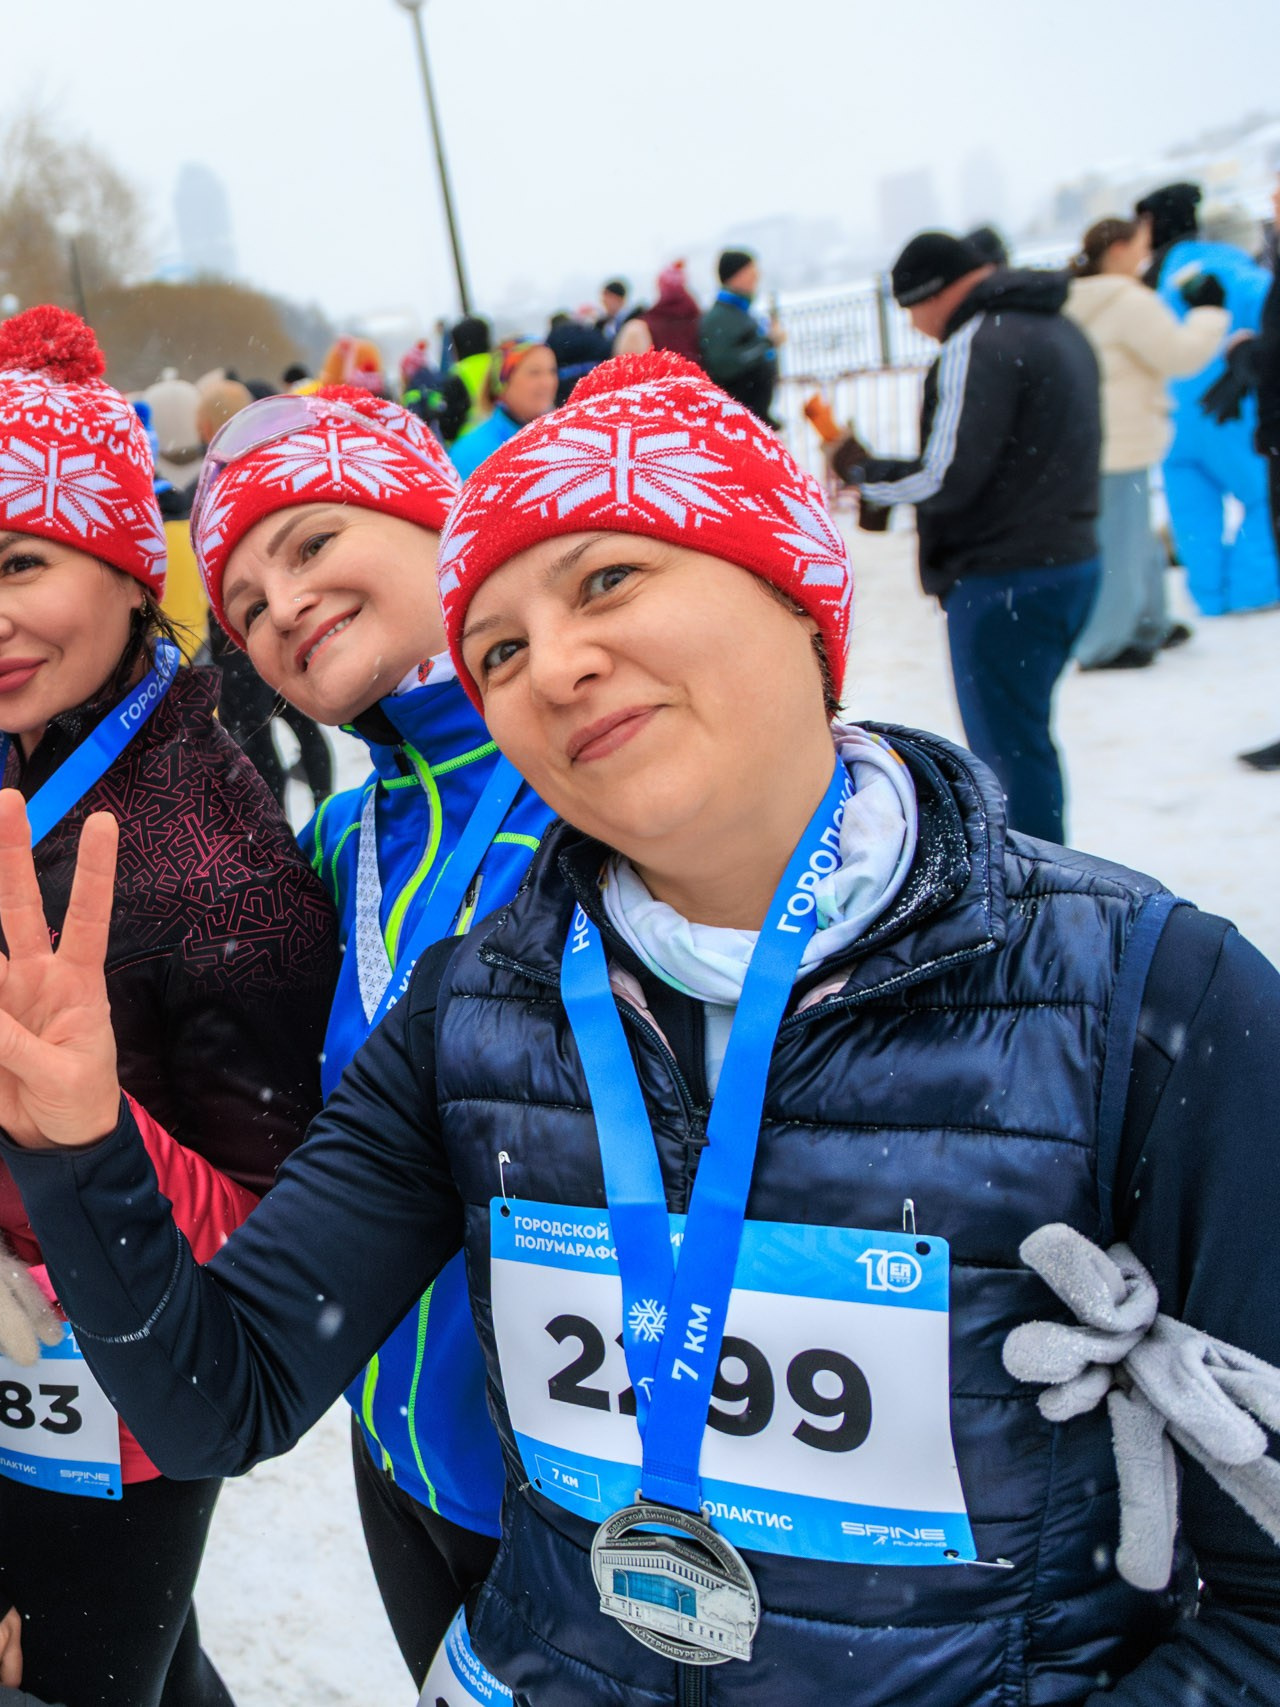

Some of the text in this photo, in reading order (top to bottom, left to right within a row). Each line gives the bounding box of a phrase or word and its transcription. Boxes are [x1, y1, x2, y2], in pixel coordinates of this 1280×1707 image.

[514, 1215, 609, 1241] ГОРОДСКОЙ
[672, 1303, 712, 1382] 7 КМ
[60, 1469, 111, 1481] SPINE
[840, 1521, 946, 1541] SPINE
